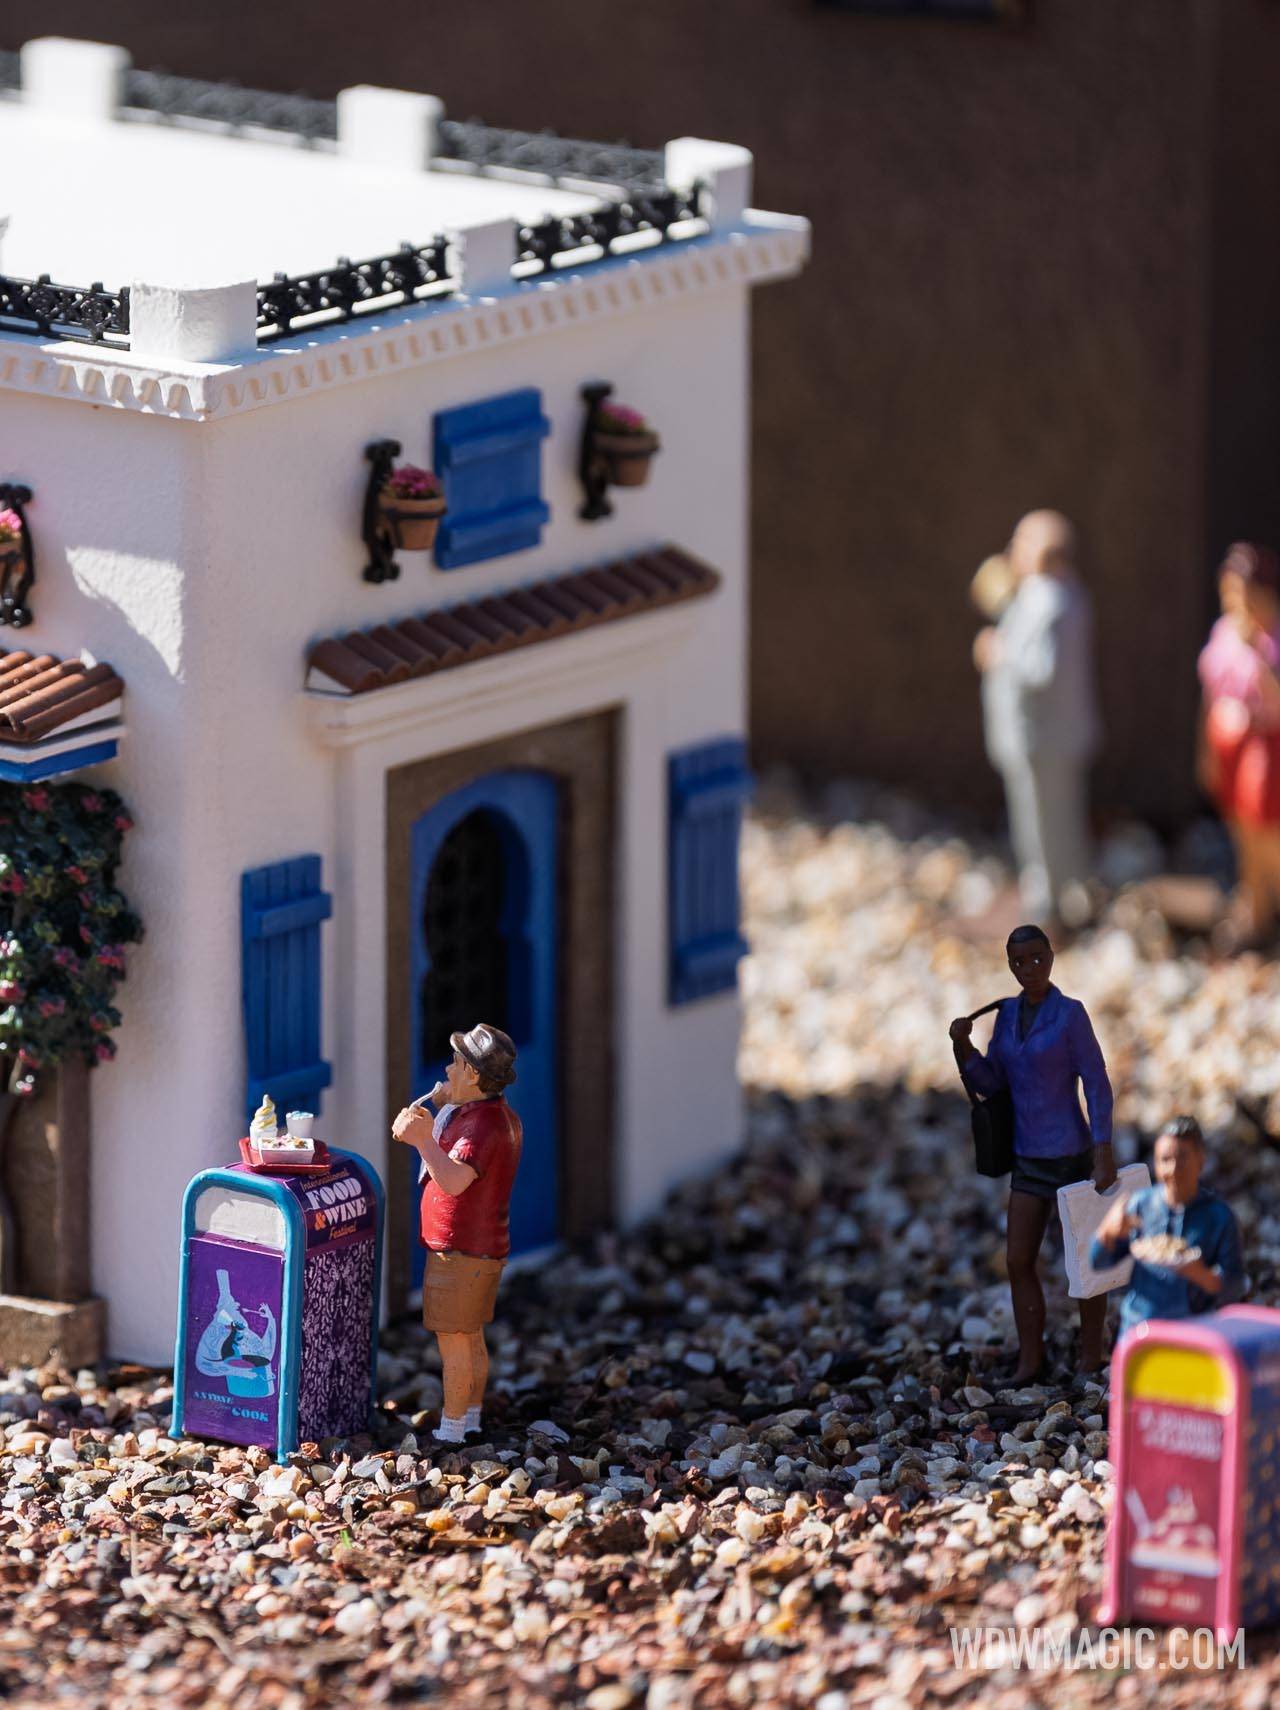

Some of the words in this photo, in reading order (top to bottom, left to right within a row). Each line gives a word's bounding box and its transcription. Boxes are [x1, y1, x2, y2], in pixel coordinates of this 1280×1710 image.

[305, 1177, 362, 1210] FOOD
[324, 1196, 367, 1225] WINE
[231, 1407, 269, 1422] COOK
